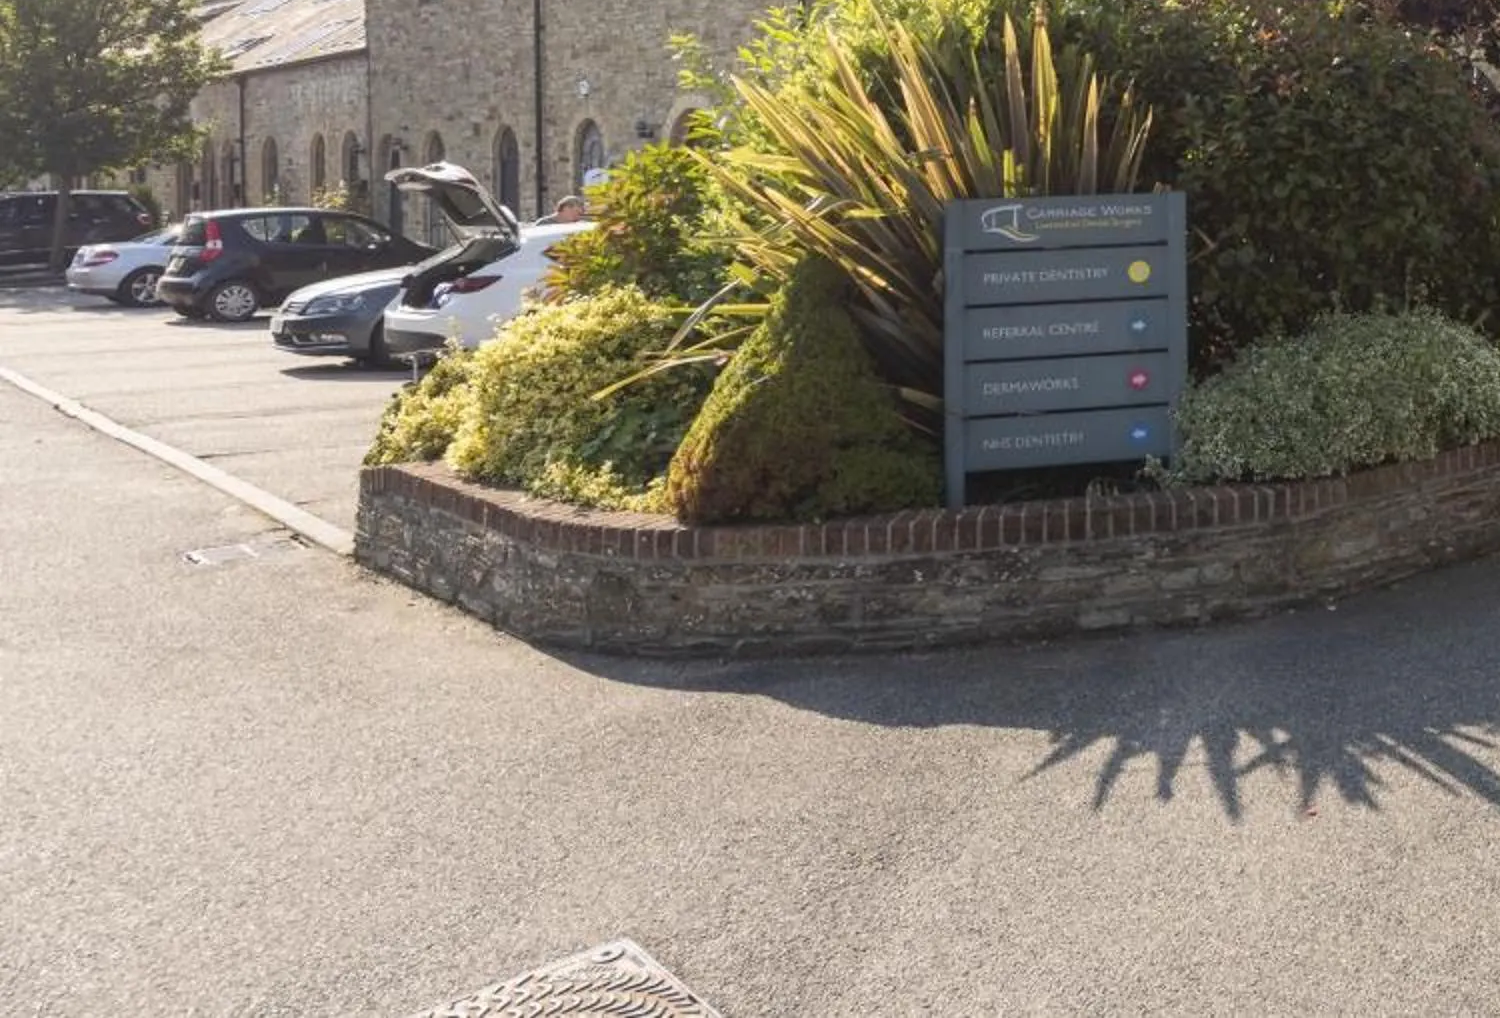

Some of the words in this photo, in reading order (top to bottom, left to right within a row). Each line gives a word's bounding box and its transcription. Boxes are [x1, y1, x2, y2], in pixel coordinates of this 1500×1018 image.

[1026, 205, 1096, 220] CARRIAGE
[1100, 204, 1153, 217] WORKS
[983, 272, 1035, 285] PRIVATE
[1039, 267, 1109, 282] DENTISTRY
[982, 325, 1045, 339] REFERRAL
[1049, 321, 1100, 336] CENTRE
[983, 377, 1079, 395] DERMAWORKS
[983, 438, 1012, 451] NHS
[1015, 432, 1085, 448] DENTISTRY
